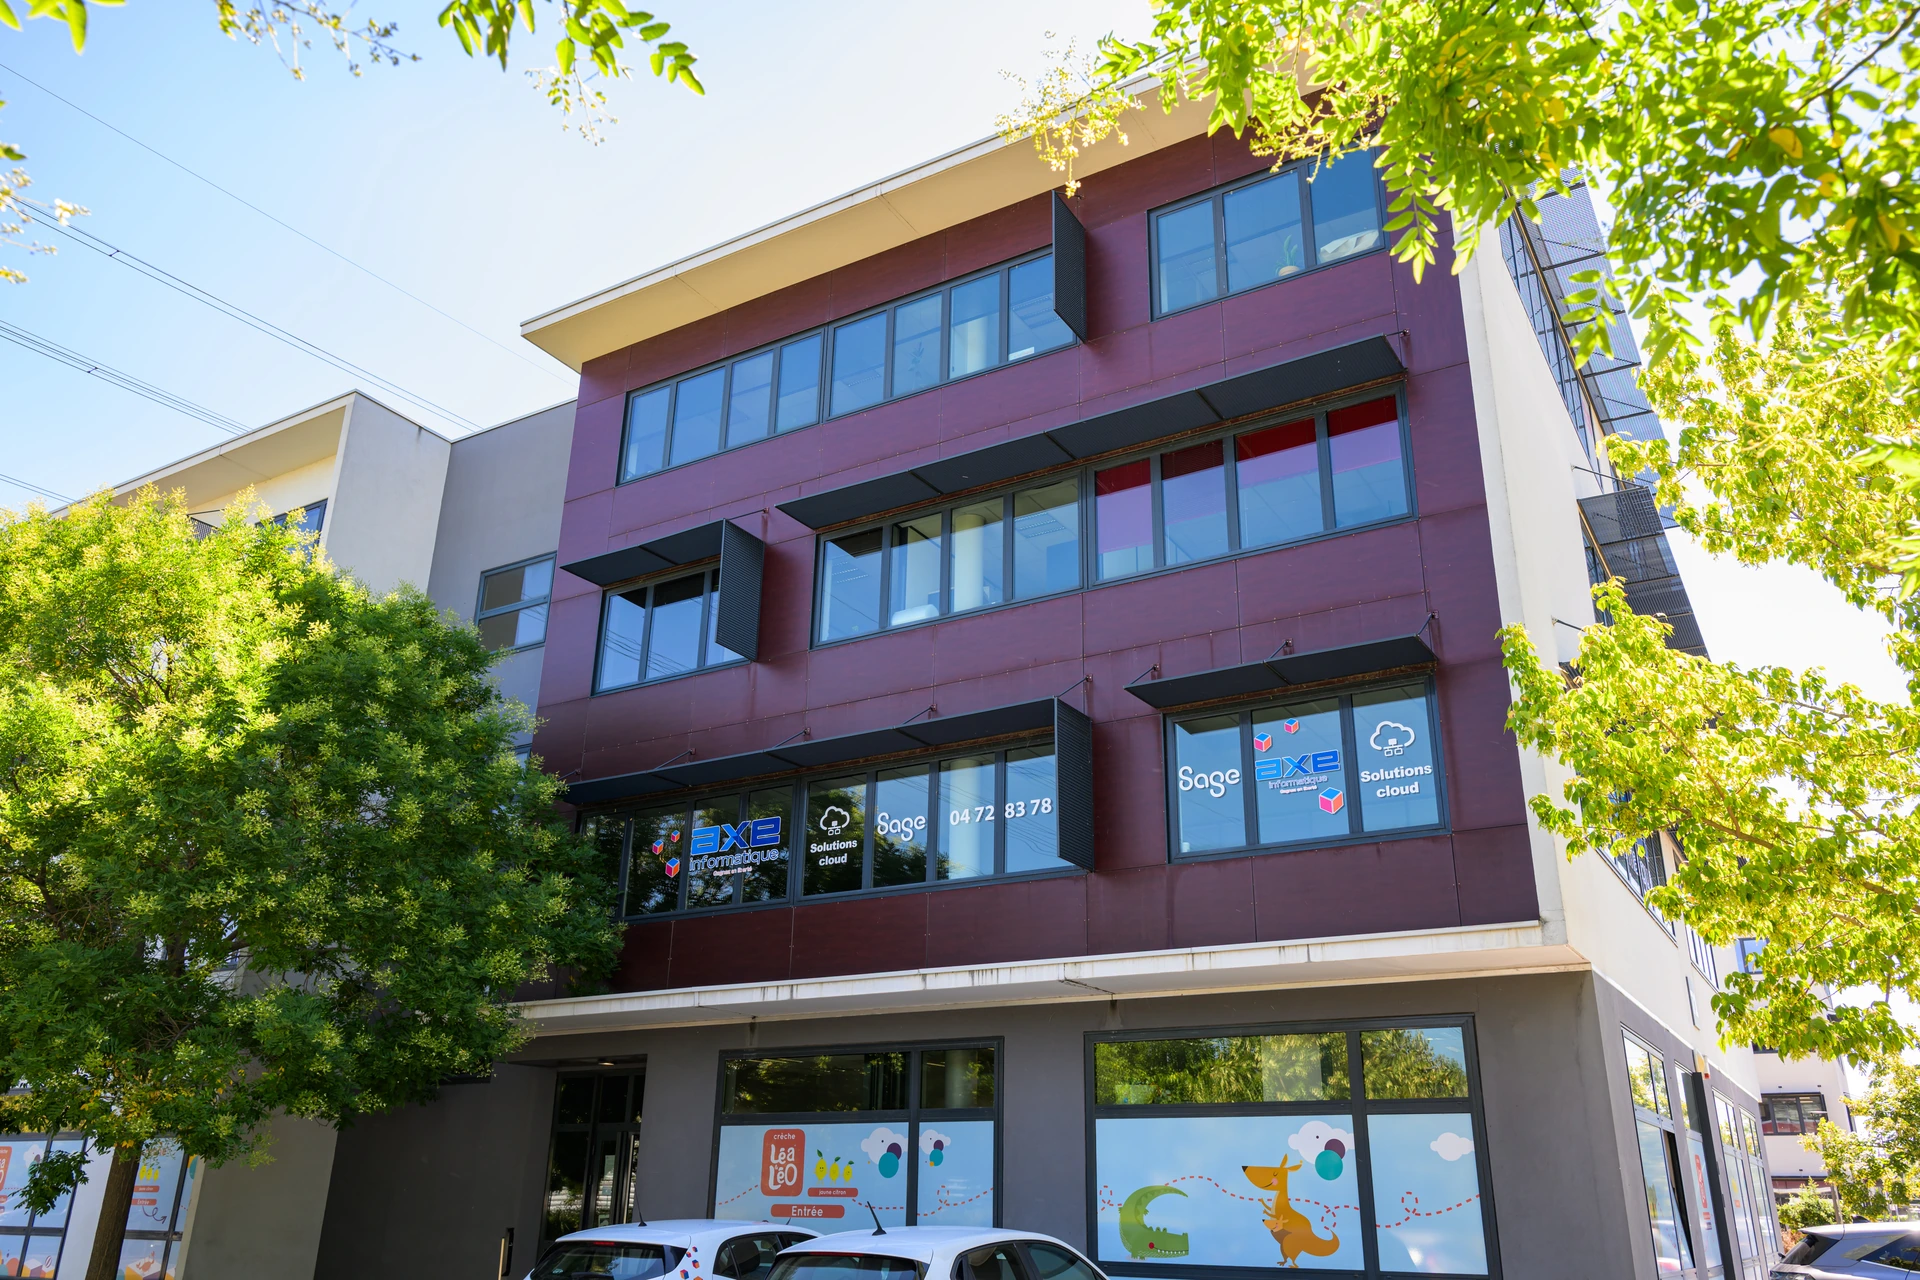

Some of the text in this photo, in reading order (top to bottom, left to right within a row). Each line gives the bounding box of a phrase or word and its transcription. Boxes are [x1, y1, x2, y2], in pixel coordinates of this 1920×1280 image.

[1255, 749, 1341, 781] axe
[1360, 764, 1433, 783] Solutions
[1179, 765, 1240, 798] Sage
[1268, 775, 1328, 789] informatique
[1376, 781, 1420, 798] cloud
[949, 797, 1053, 826] 04 72 83 78
[690, 816, 781, 855] axe
[877, 812, 926, 842] Sage
[809, 839, 858, 854] Solutions
[689, 848, 779, 872] informatique
[818, 853, 848, 866] cloud
[773, 1132, 796, 1140] crèche
[791, 1205, 824, 1217] Entrée
